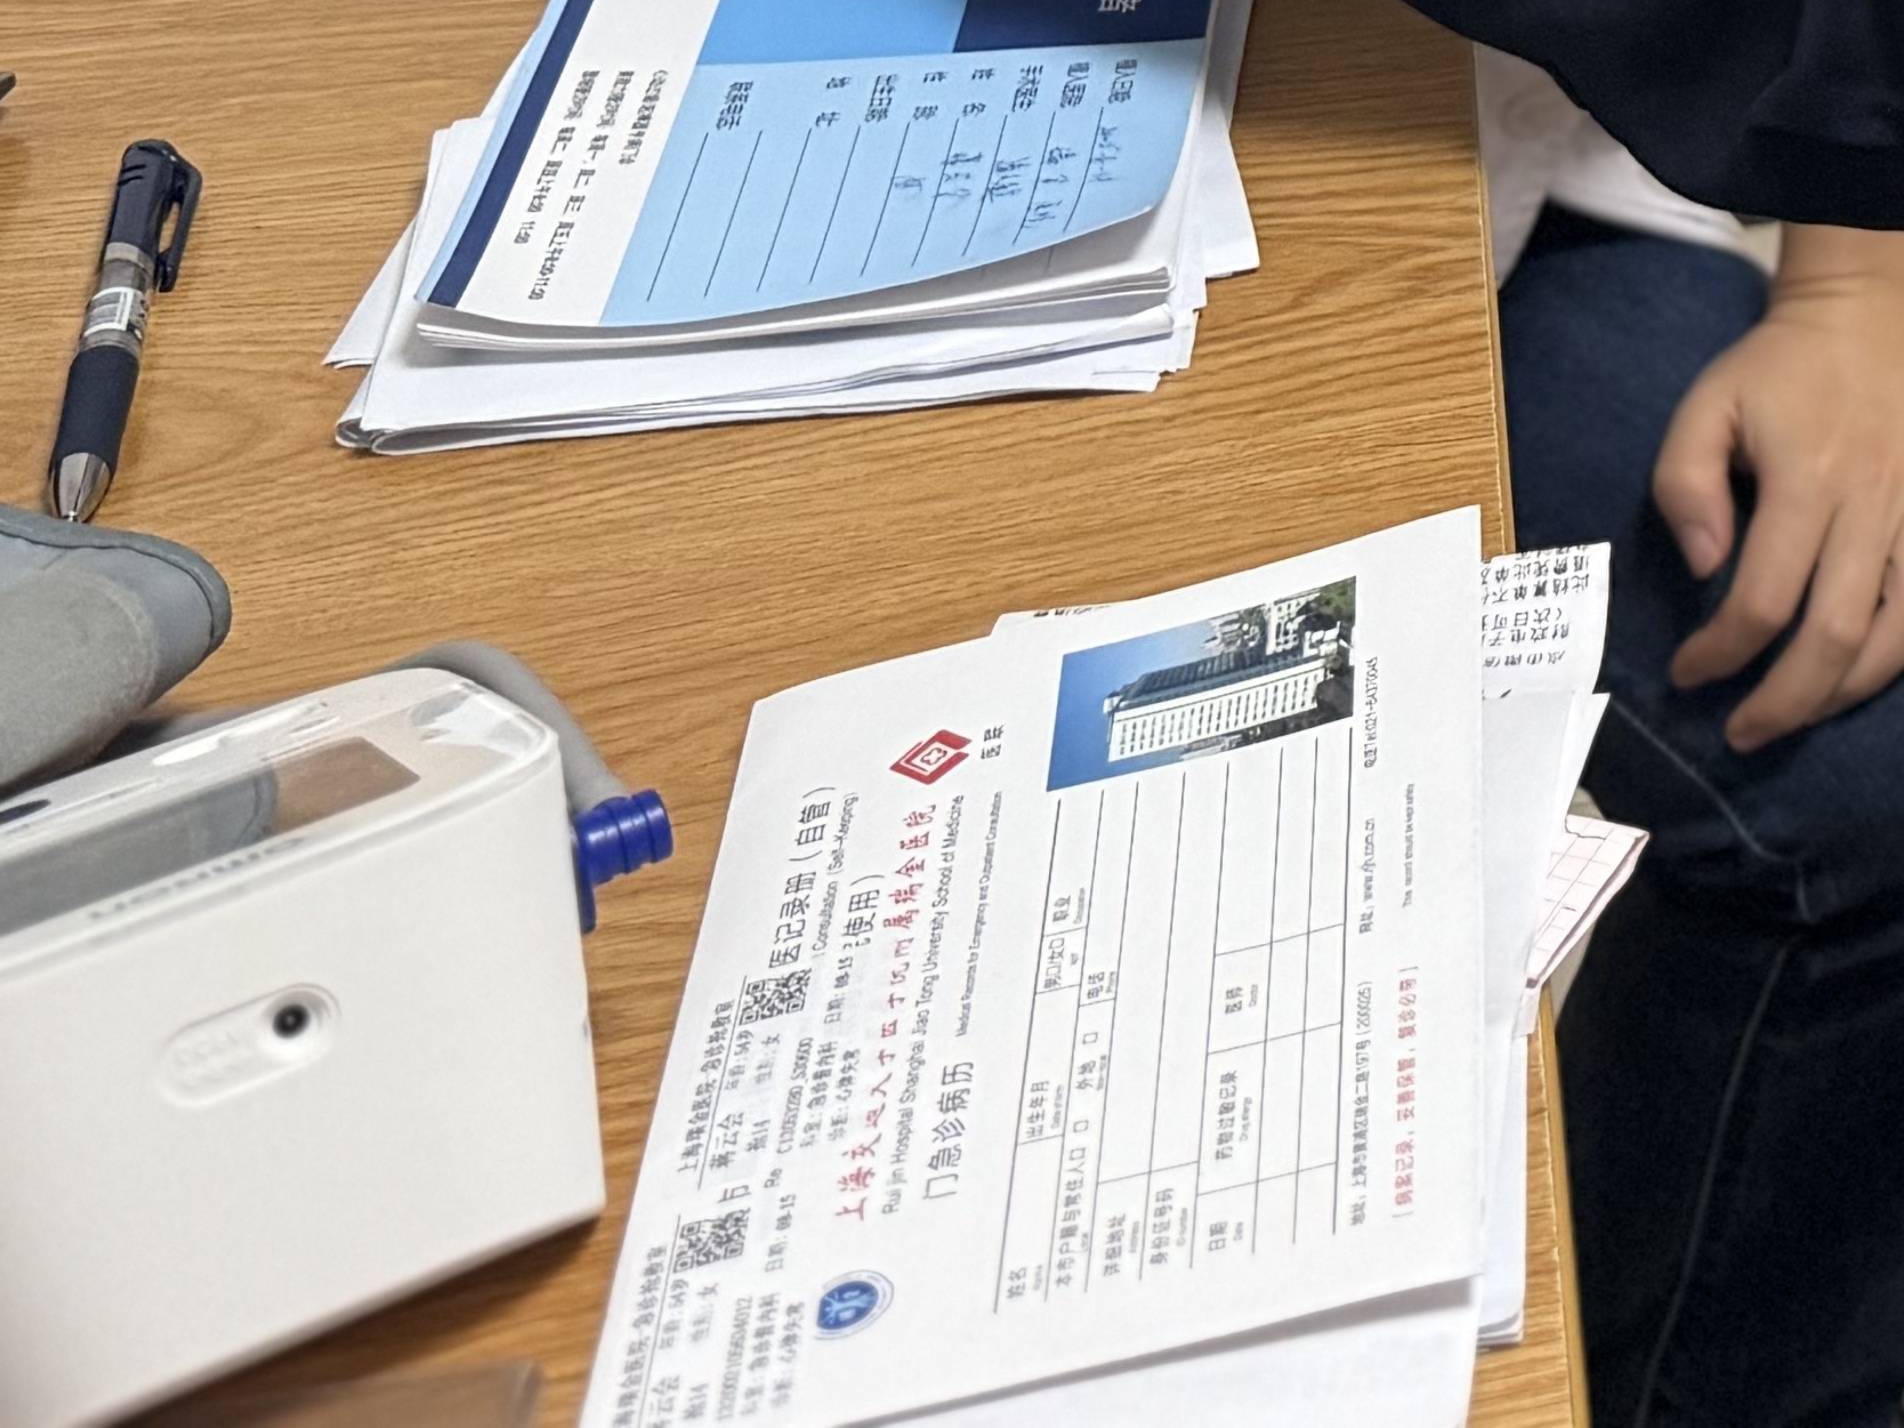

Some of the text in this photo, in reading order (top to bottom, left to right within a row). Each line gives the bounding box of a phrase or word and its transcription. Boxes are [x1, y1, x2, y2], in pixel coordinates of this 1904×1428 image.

[940, 794, 964, 849] Medicine
[930, 864, 953, 908] School
[921, 910, 949, 973] University
[913, 973, 940, 1008] Tong
[1085, 970, 1105, 1000] 电话
[910, 1008, 930, 1036] Jiao
[898, 1039, 926, 1104] Shanghai
[890, 1106, 914, 1164] Hospital
[923, 1061, 973, 1199] 门急诊病历
[1207, 1221, 1228, 1252] 日期
